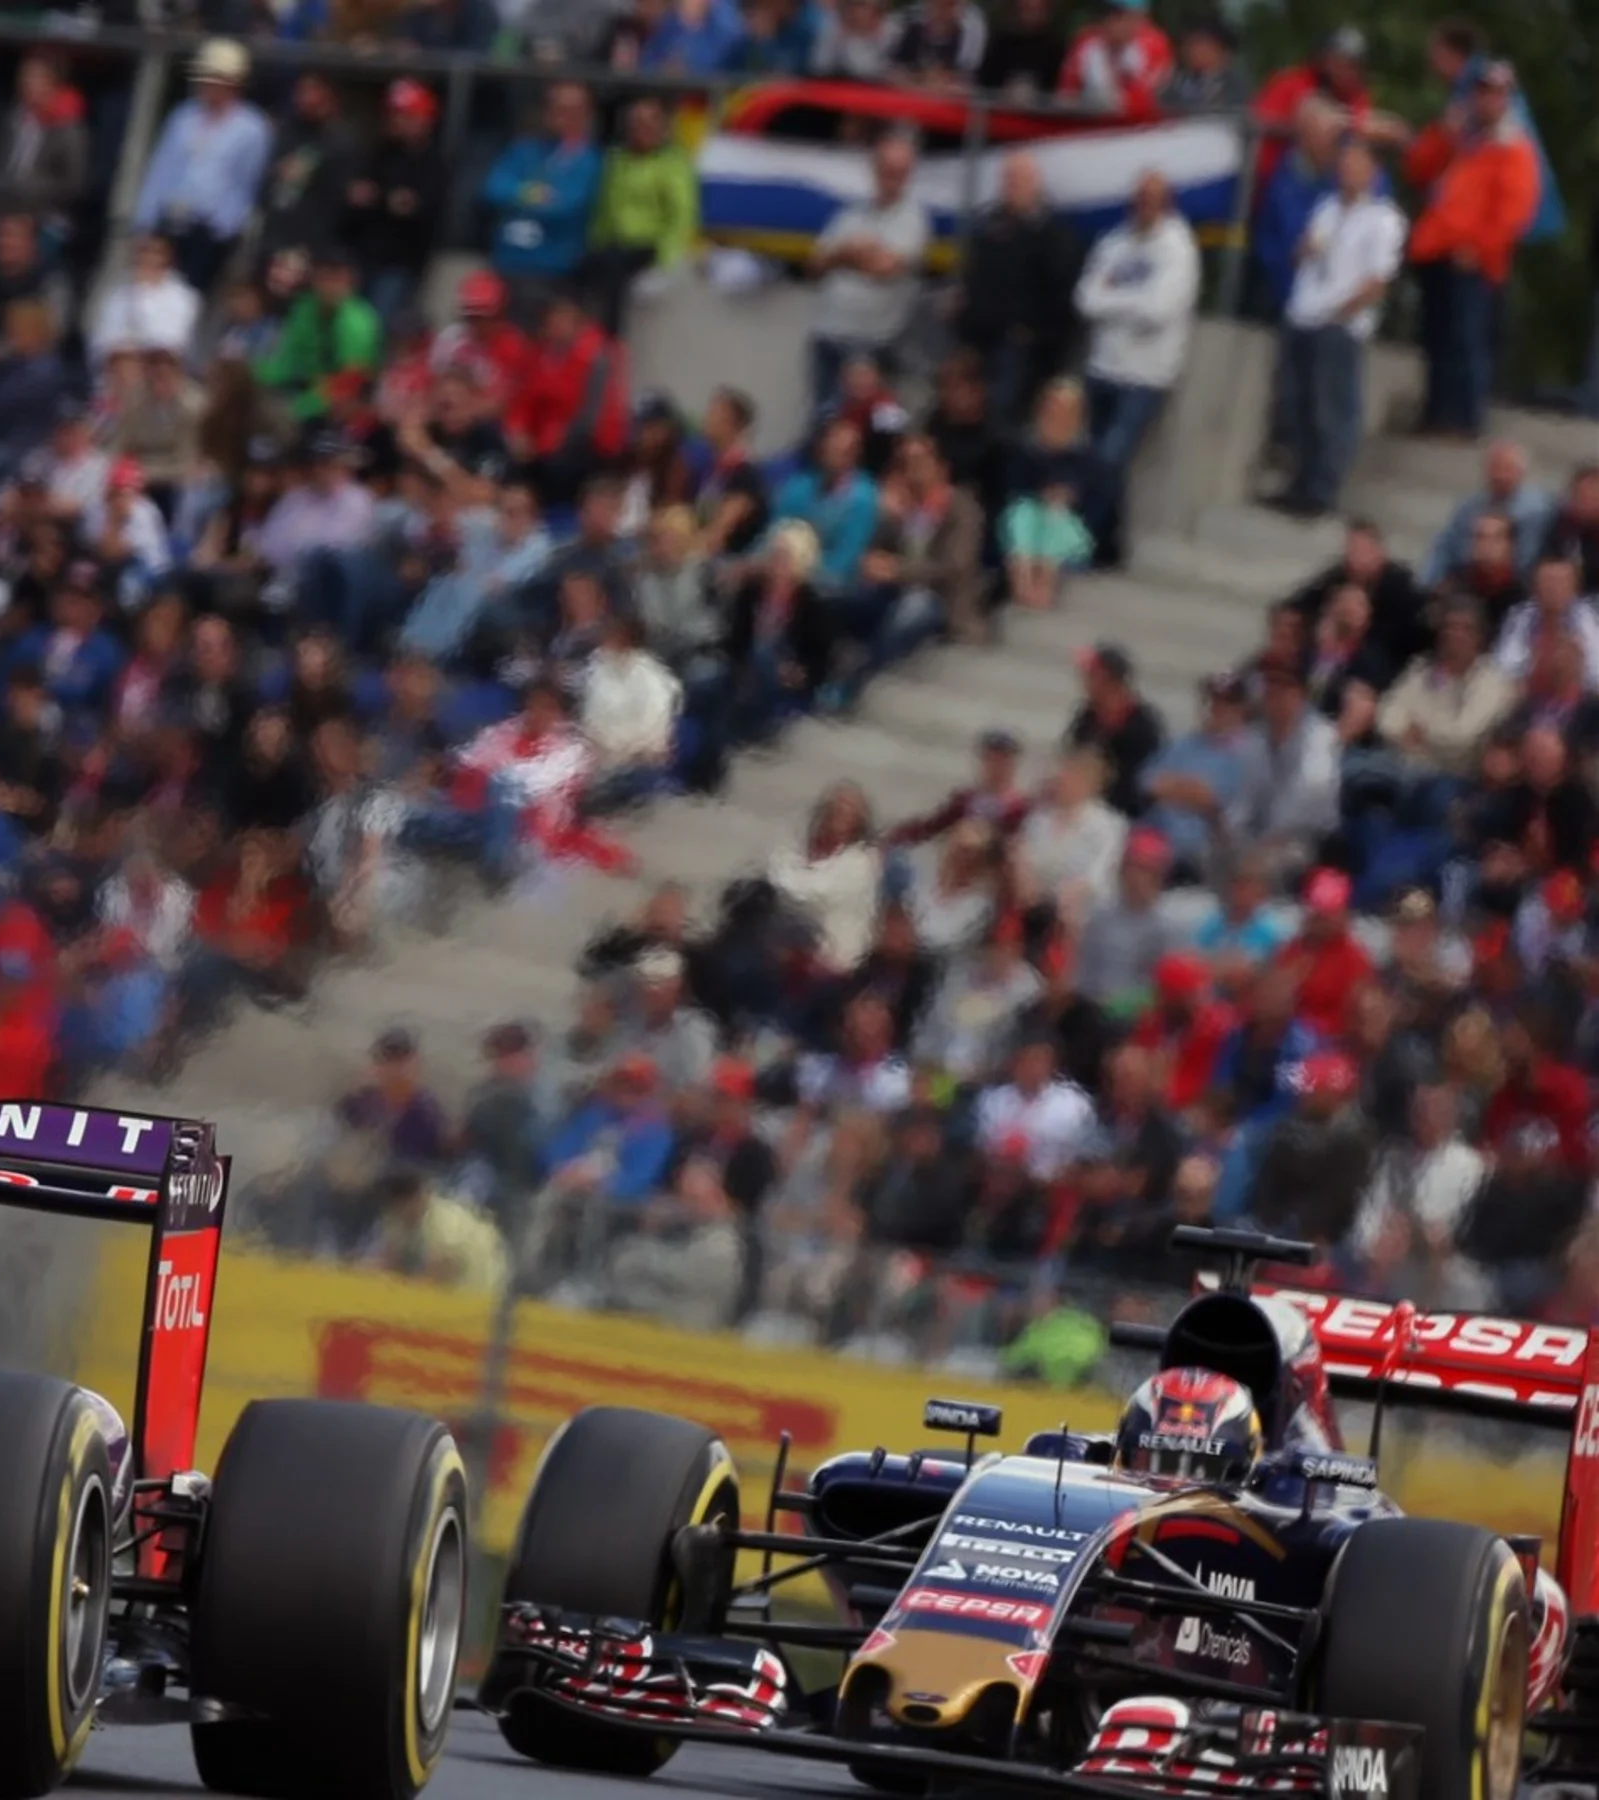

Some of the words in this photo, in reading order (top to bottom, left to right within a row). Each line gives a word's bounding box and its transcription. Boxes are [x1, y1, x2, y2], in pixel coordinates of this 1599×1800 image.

[1138, 1432, 1226, 1457] RENAULT
[952, 1514, 1091, 1542] RENAULT
[939, 1532, 1077, 1564] PIRELLI
[975, 1563, 1060, 1587] NOVA
[1208, 1570, 1256, 1602] NOVA
[907, 1590, 1043, 1623] CEPSA
